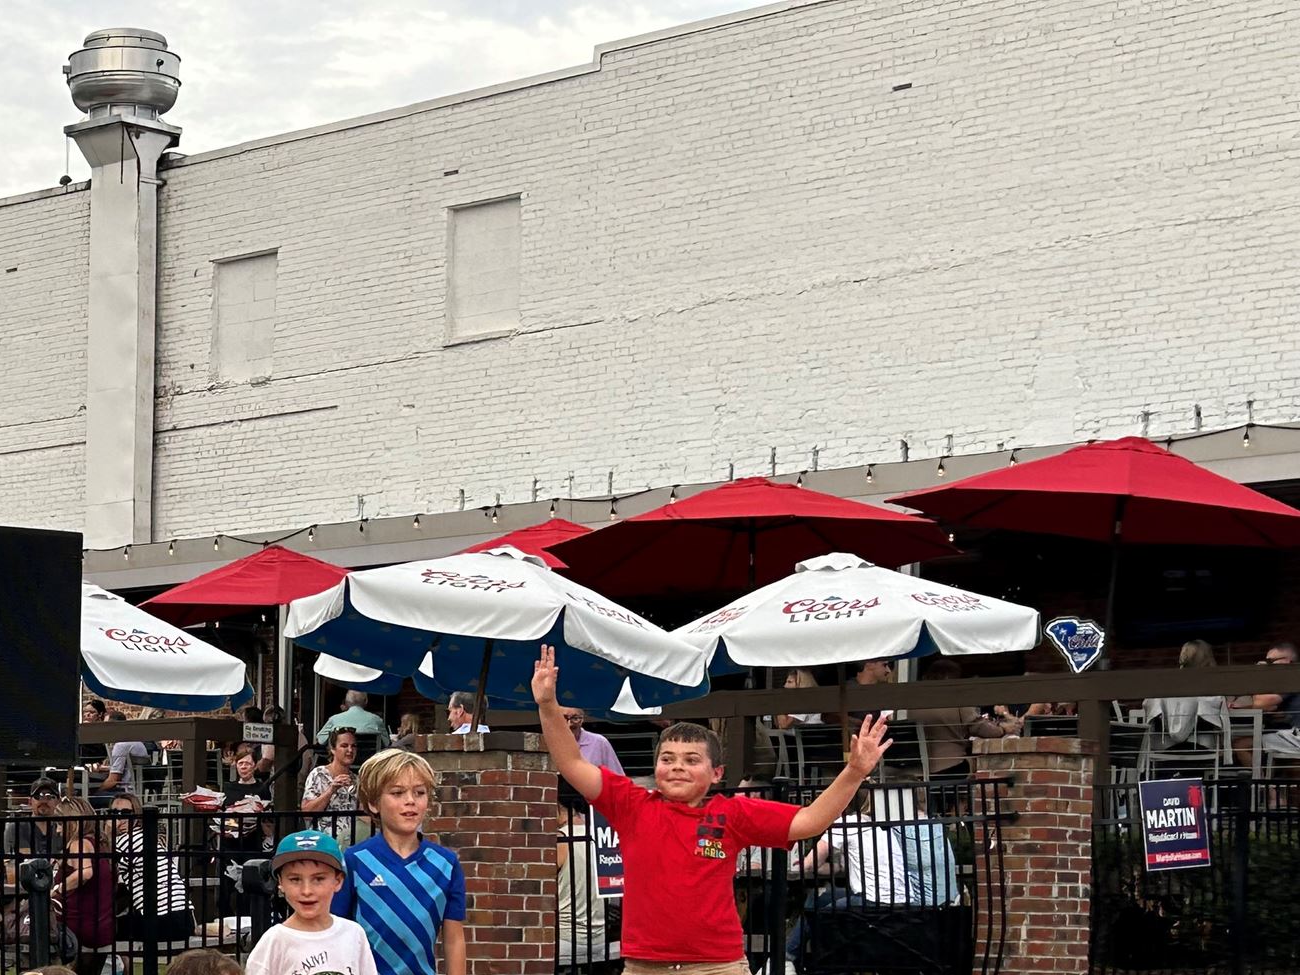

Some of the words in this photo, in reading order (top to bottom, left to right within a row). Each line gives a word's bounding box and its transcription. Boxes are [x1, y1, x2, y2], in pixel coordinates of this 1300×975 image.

[421, 569, 526, 589] Coors
[782, 596, 882, 614] Coors
[789, 609, 867, 623] LIGHT
[99, 627, 191, 647] Coors
[120, 641, 187, 654] LIGHT
[1146, 807, 1197, 829] MARTIN
